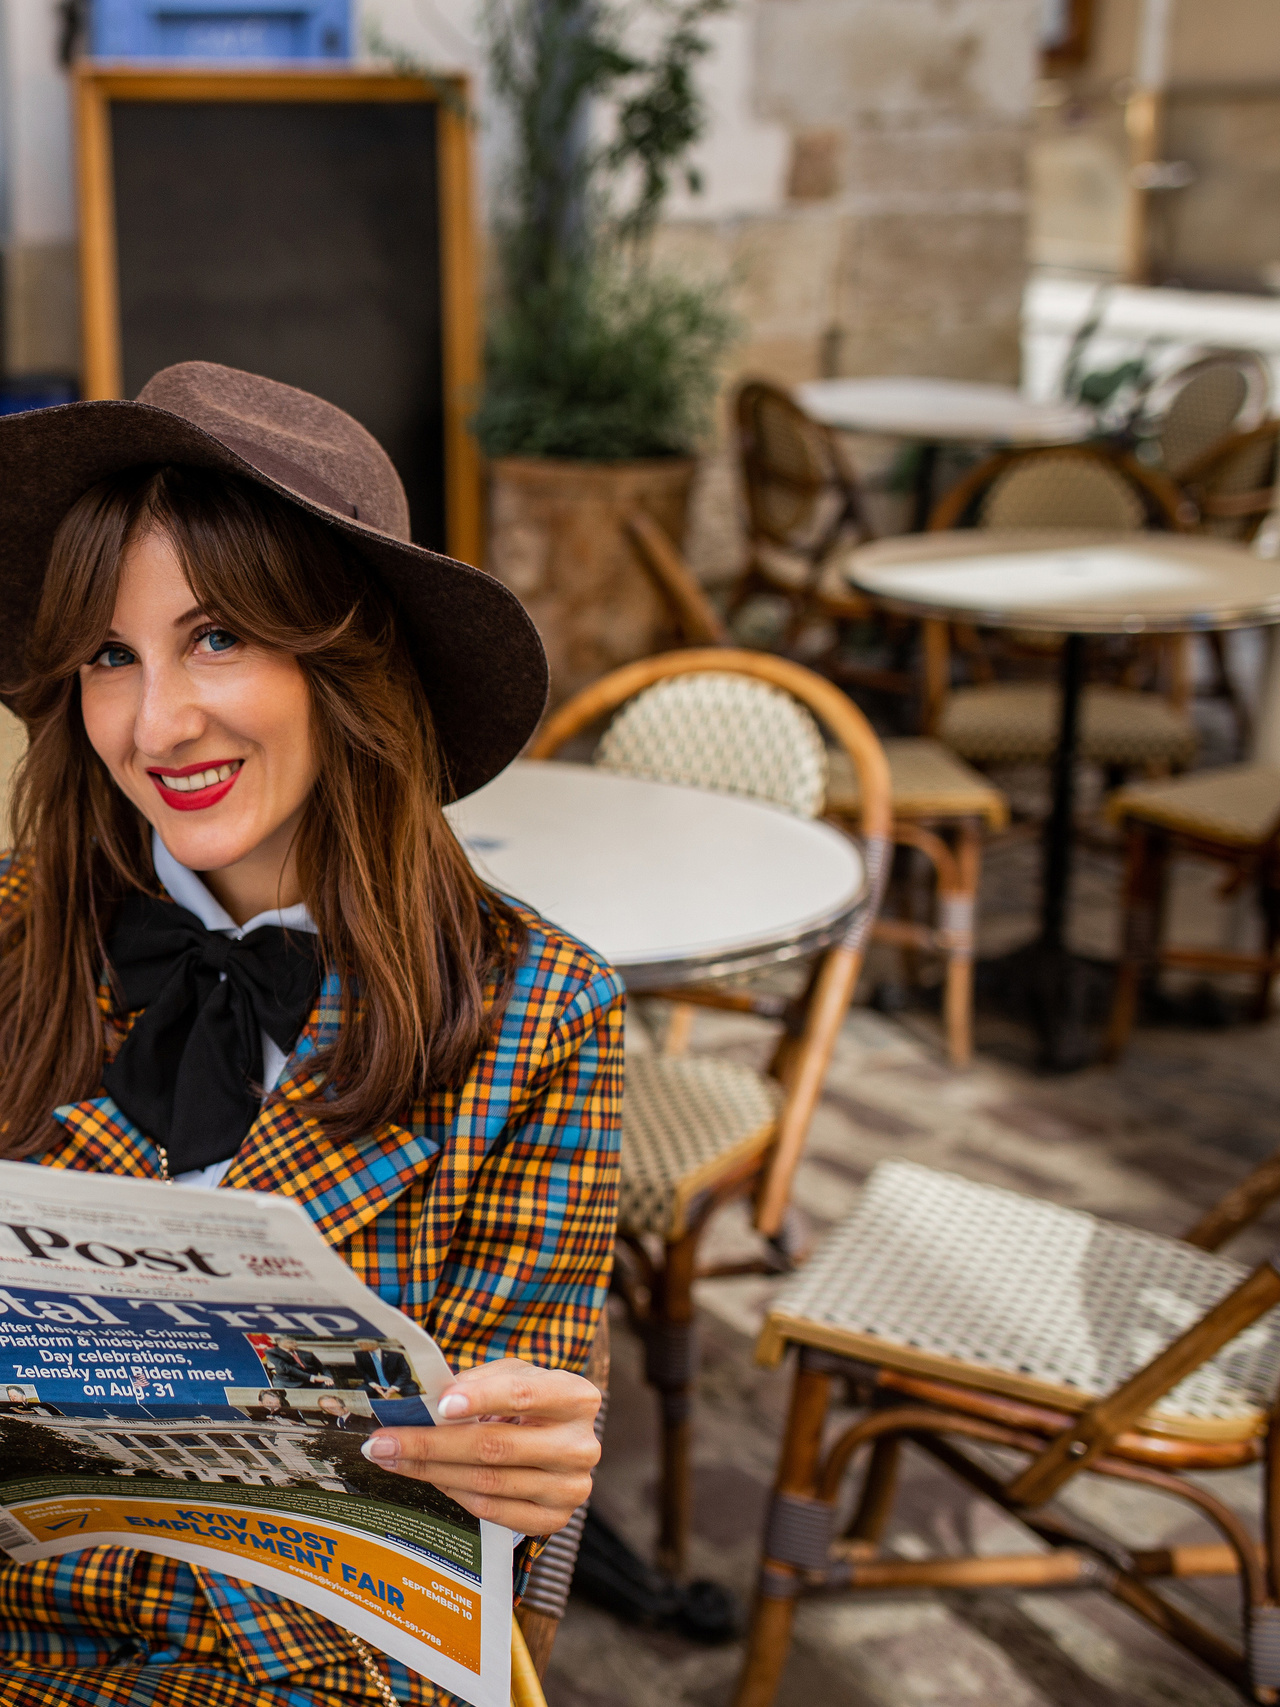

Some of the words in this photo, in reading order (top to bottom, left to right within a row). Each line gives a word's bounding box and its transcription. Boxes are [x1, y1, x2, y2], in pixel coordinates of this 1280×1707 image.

[127, 1300, 359, 1338] Trip
[38, 1324, 96, 1337] Merkel
[98, 1328, 144, 1339] visit,
[145, 1329, 211, 1340] Crimea
[77, 1337, 90, 1348] &
[92, 1336, 220, 1351] Independence
[39, 1350, 73, 1366] Day
[78, 1351, 192, 1366] celebrations,
[12, 1365, 90, 1382] Zelensky
[95, 1366, 128, 1380] and
[132, 1366, 183, 1380] Biden
[187, 1367, 235, 1381] meet
[83, 1384, 106, 1397] on
[110, 1382, 150, 1400] Aug.
[154, 1382, 175, 1398] 31
[23, 1504, 64, 1516] ONLINE
[28, 1507, 92, 1520] SEPTEMBER
[175, 1509, 248, 1530] KYIV
[259, 1520, 338, 1556] POST
[124, 1515, 333, 1574] EMPLOYMENT
[341, 1562, 405, 1613] FAIR
[386, 1533, 397, 1542] See
[396, 1538, 409, 1547] story
[415, 1546, 428, 1556] page
[439, 1557, 458, 1571] editorial
[288, 1564, 385, 1615] events@kyivpost.com,
[386, 1609, 442, 1647] 044-591-7788
[401, 1576, 460, 1615] SEPTEMBER
[462, 1609, 473, 1621] 10
[431, 1580, 473, 1610] OFFLINE
